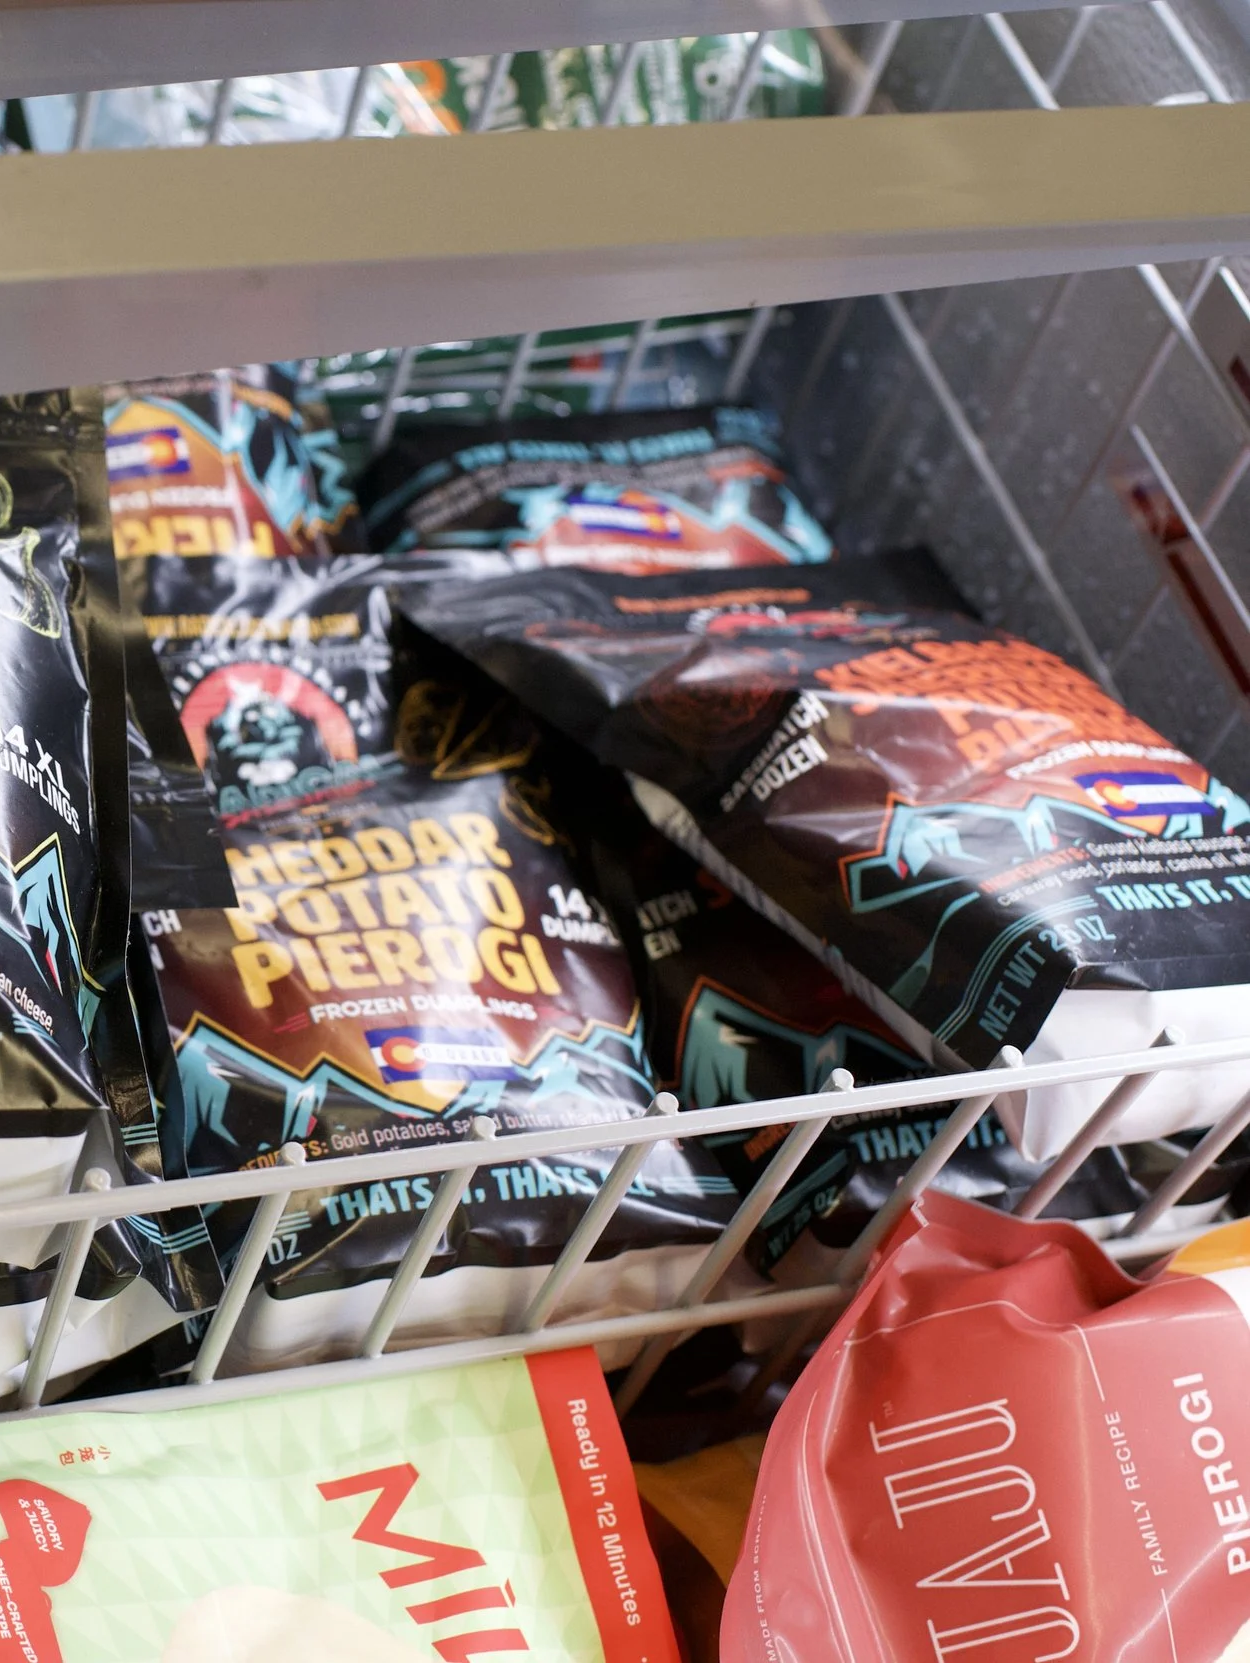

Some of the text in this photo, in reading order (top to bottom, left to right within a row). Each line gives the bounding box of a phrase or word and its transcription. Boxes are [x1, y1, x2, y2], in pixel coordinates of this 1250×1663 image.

[35, 738, 71, 800] XL
[750, 735, 829, 802] DOZEN
[225, 813, 513, 888] HEDDAR
[223, 868, 525, 942] POTATO
[548, 883, 592, 920] 14
[1096, 883, 1192, 911] THATS
[1186, 878, 1233, 904] IT,
[230, 926, 561, 1009] PIEROGI
[979, 915, 1116, 1041] NET WT 26 OZ
[14, 987, 54, 1036] cheese,
[310, 993, 537, 1025] FROZEN DUMPLINGS
[331, 1128, 370, 1151] Gold
[373, 1117, 450, 1146] potatoes,
[320, 1177, 435, 1226] THATS
[491, 1163, 600, 1200] THATS
[267, 1232, 302, 1266] OZ
[1102, 1411, 1168, 1576] FAMILY RECIPE
[1173, 1373, 1250, 1575] PIEROGI
[18, 1498, 50, 1553] & JUICY
[33, 1499, 65, 1551] SAVORY
[567, 1398, 641, 1627] Ready in 12 Minutes
[869, 1398, 1080, 1663] JAJU
[753, 1570, 766, 1613] FROM
[760, 1618, 777, 1662] MADE
